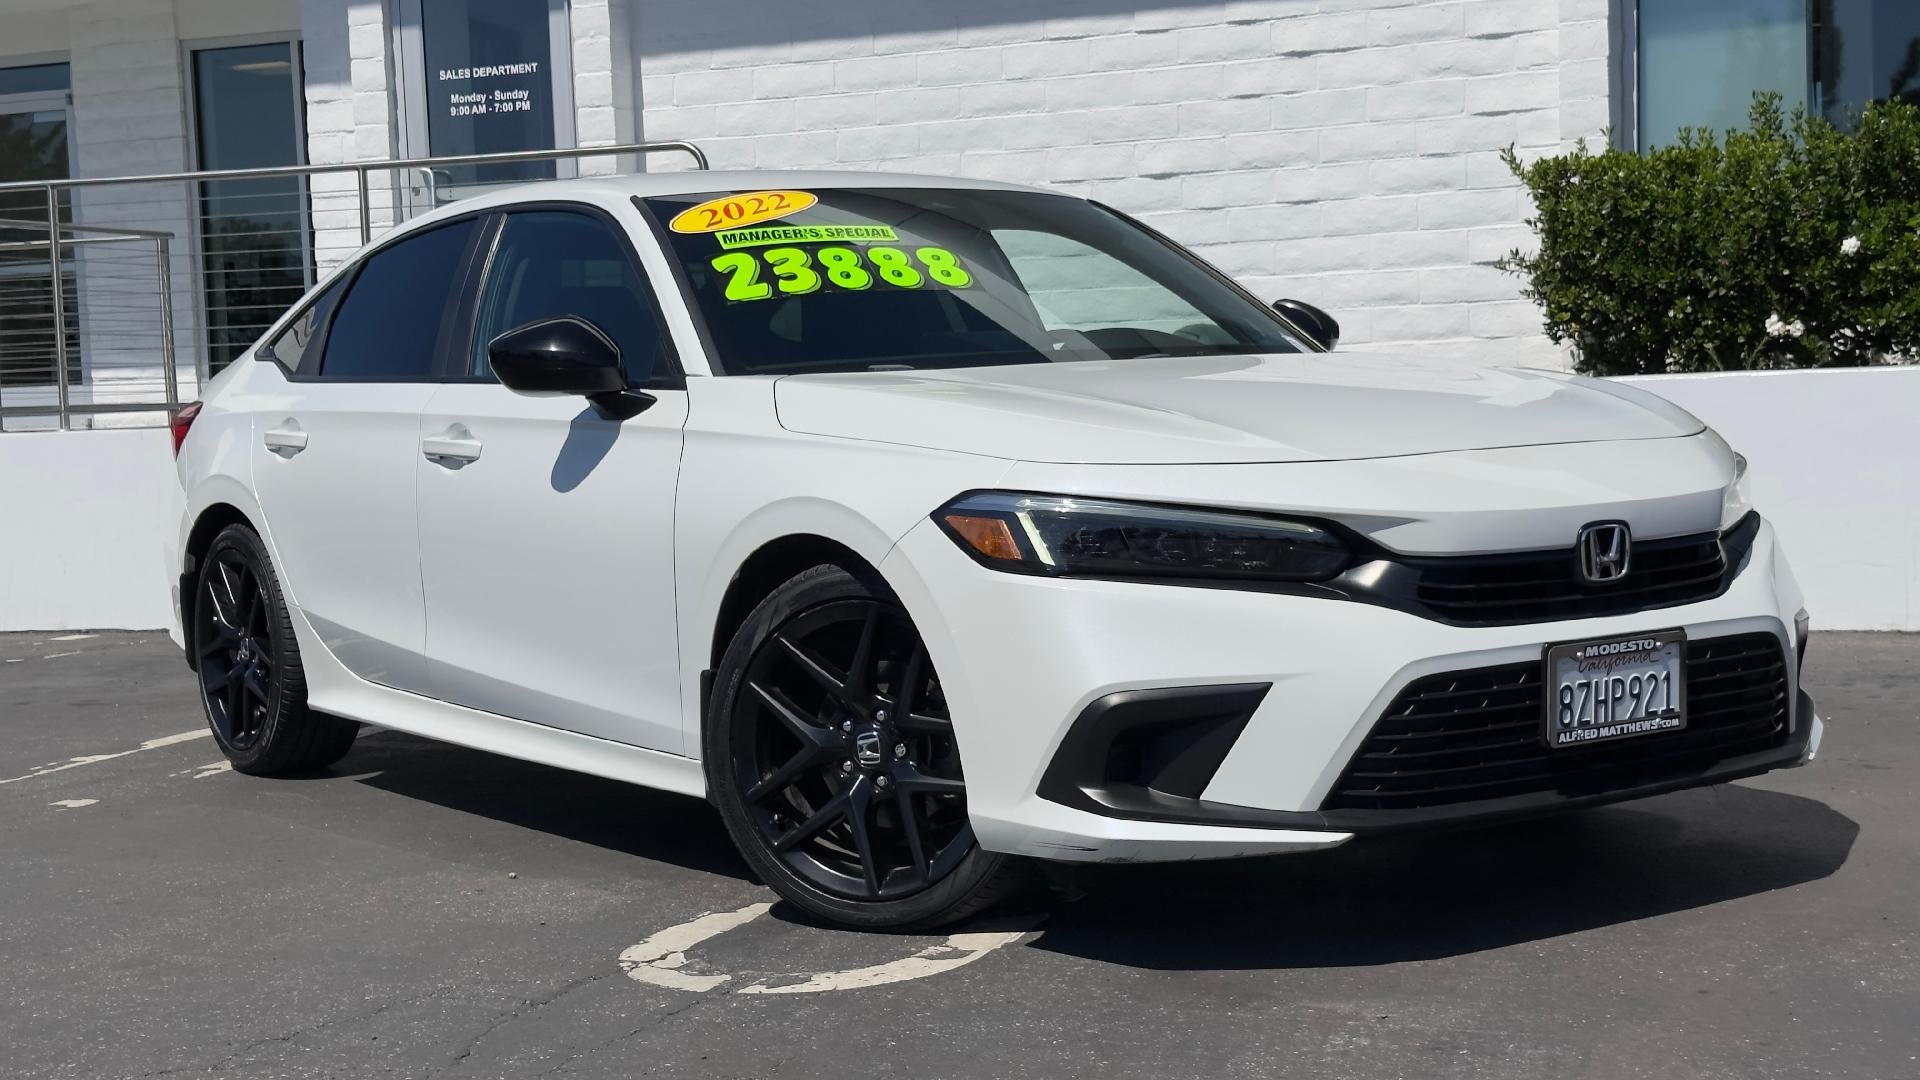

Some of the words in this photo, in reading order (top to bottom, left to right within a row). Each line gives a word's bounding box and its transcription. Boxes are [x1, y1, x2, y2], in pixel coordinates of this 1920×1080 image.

[439, 69, 471, 81] SALES
[472, 62, 538, 78] DEPARTMENT
[450, 92, 486, 104] Monday
[494, 89, 529, 101] Sunday
[450, 106, 470, 117] 9:00
[471, 104, 487, 115] AM
[494, 102, 514, 113] 7:00
[515, 100, 531, 112] PM
[699, 193, 791, 228] 2022
[721, 228, 820, 244] MANAGER'S
[826, 227, 894, 239] SPECIAL
[711, 247, 973, 301] 23888
[1585, 639, 1655, 657] MODESTO
[1576, 653, 1660, 676] California
[1559, 670, 1675, 728] 8ZHP921
[1558, 728, 1598, 744] ALFRED
